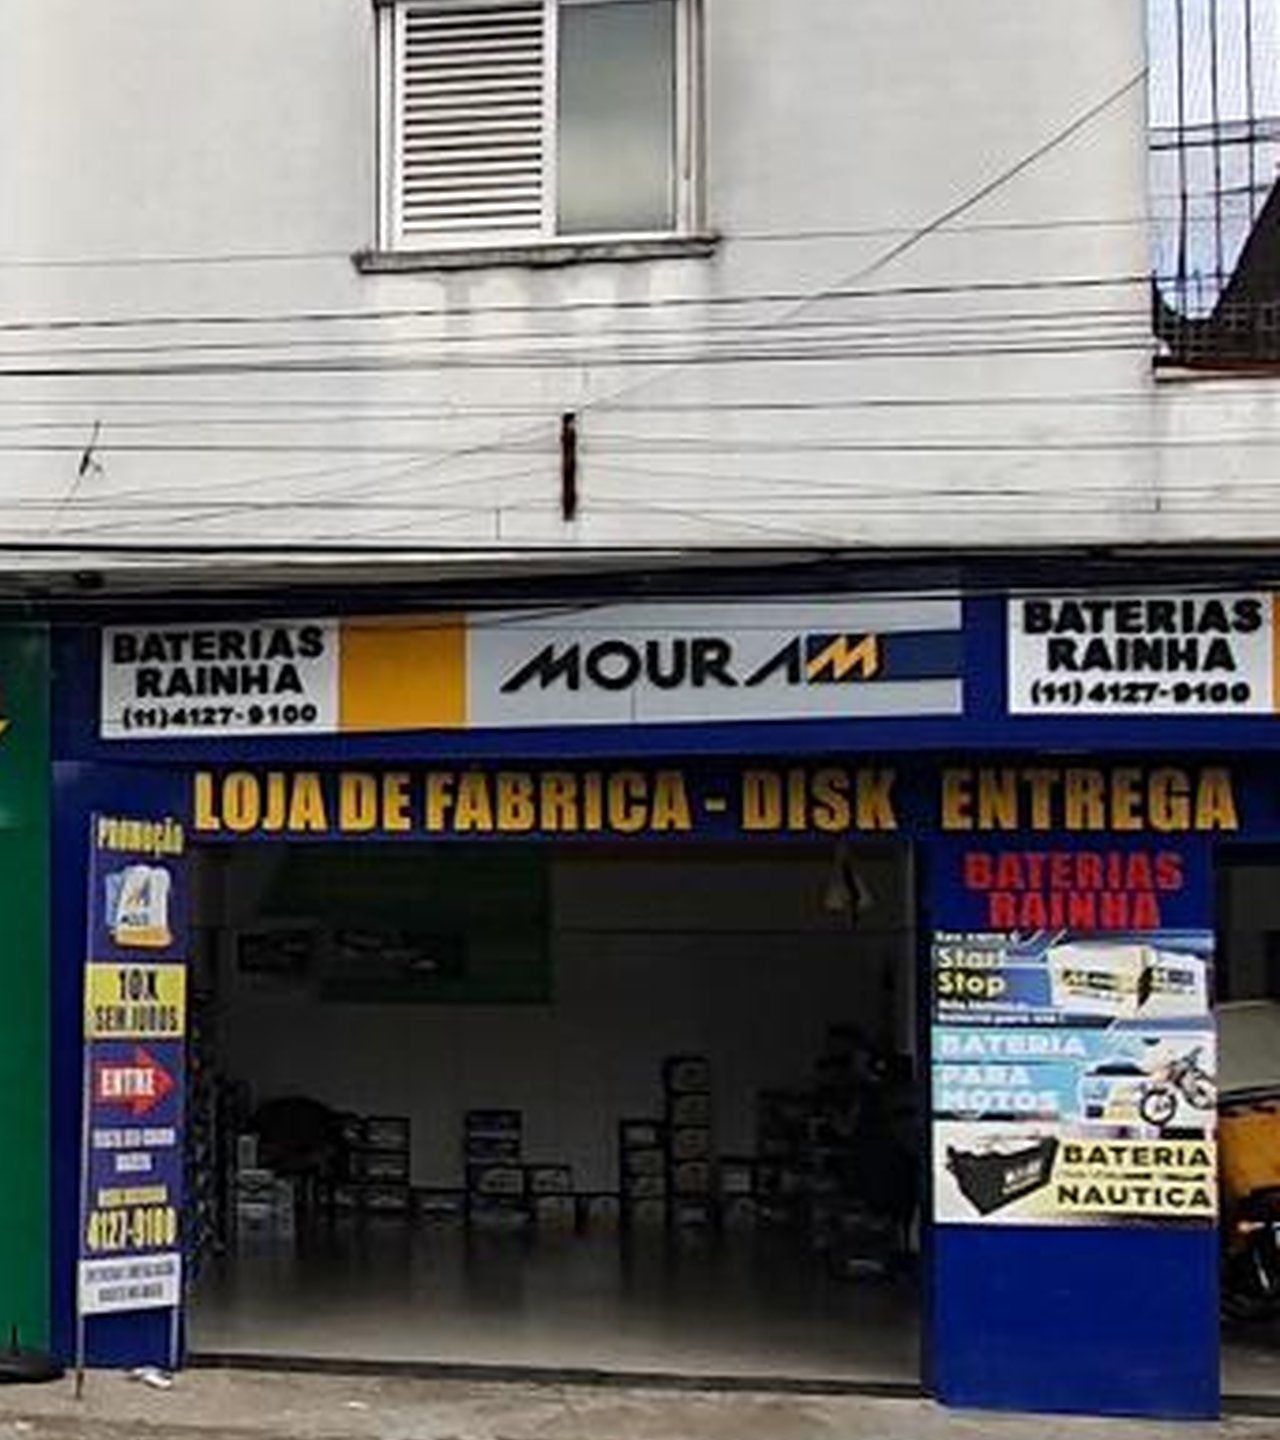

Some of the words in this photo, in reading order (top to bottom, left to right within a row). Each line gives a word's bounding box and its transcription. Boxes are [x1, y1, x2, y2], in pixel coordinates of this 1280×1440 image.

[1023, 599, 1263, 635] BATERIAS
[112, 625, 325, 664] BATERIAS
[1046, 637, 1237, 672] RAINHA
[136, 663, 303, 698] RAINHA
[500, 637, 801, 693] MOURA
[194, 771, 329, 831] LOJA
[341, 771, 412, 832] DE
[741, 770, 898, 830] DISK
[941, 768, 1239, 830] ENTREGA
[964, 852, 1185, 890] BATERIAS
[989, 891, 1162, 929] RAINHA
[938, 971, 1007, 998] Stop
[941, 1034, 1087, 1056] BATERIA
[1064, 1145, 1210, 1167] BATERIA
